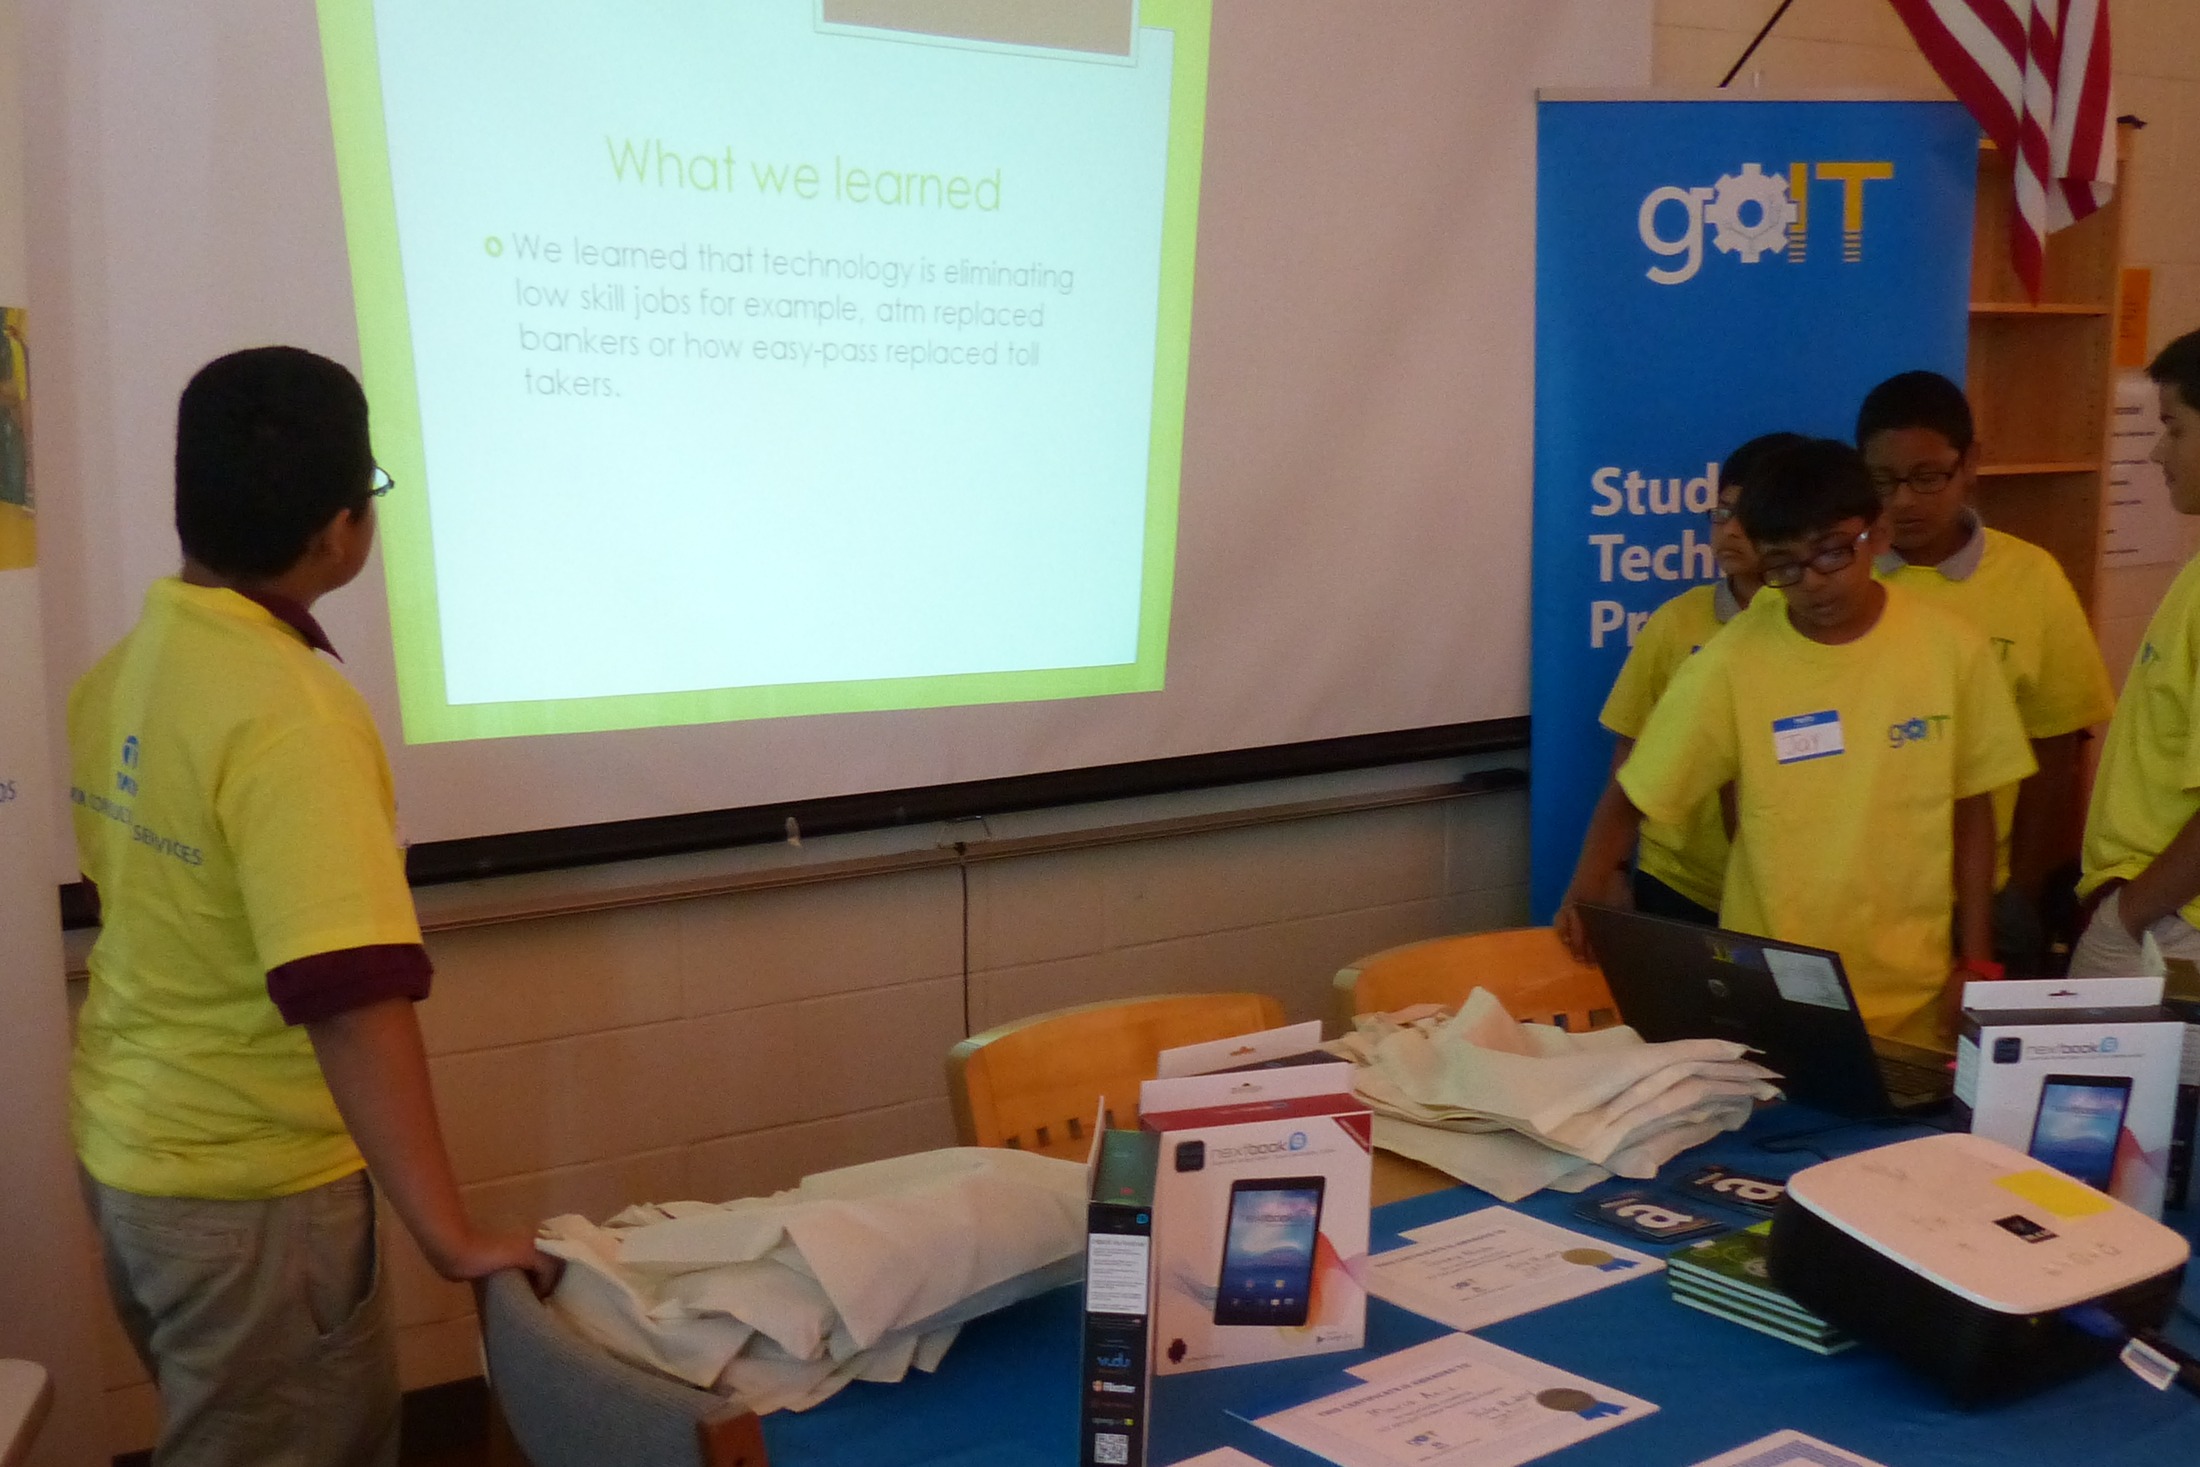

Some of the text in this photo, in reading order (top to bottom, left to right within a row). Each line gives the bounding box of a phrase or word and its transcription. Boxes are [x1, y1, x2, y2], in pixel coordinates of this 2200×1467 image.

[604, 134, 1002, 212] What we learned
[512, 232, 1075, 295] We learned that technology is eliminating
[516, 277, 1046, 332] low skill jobs for example, atm replaced
[520, 322, 1041, 370] bankers or how easy-pass replaced toll
[525, 369, 622, 399] takers.
[1588, 529, 1728, 582] Tech
